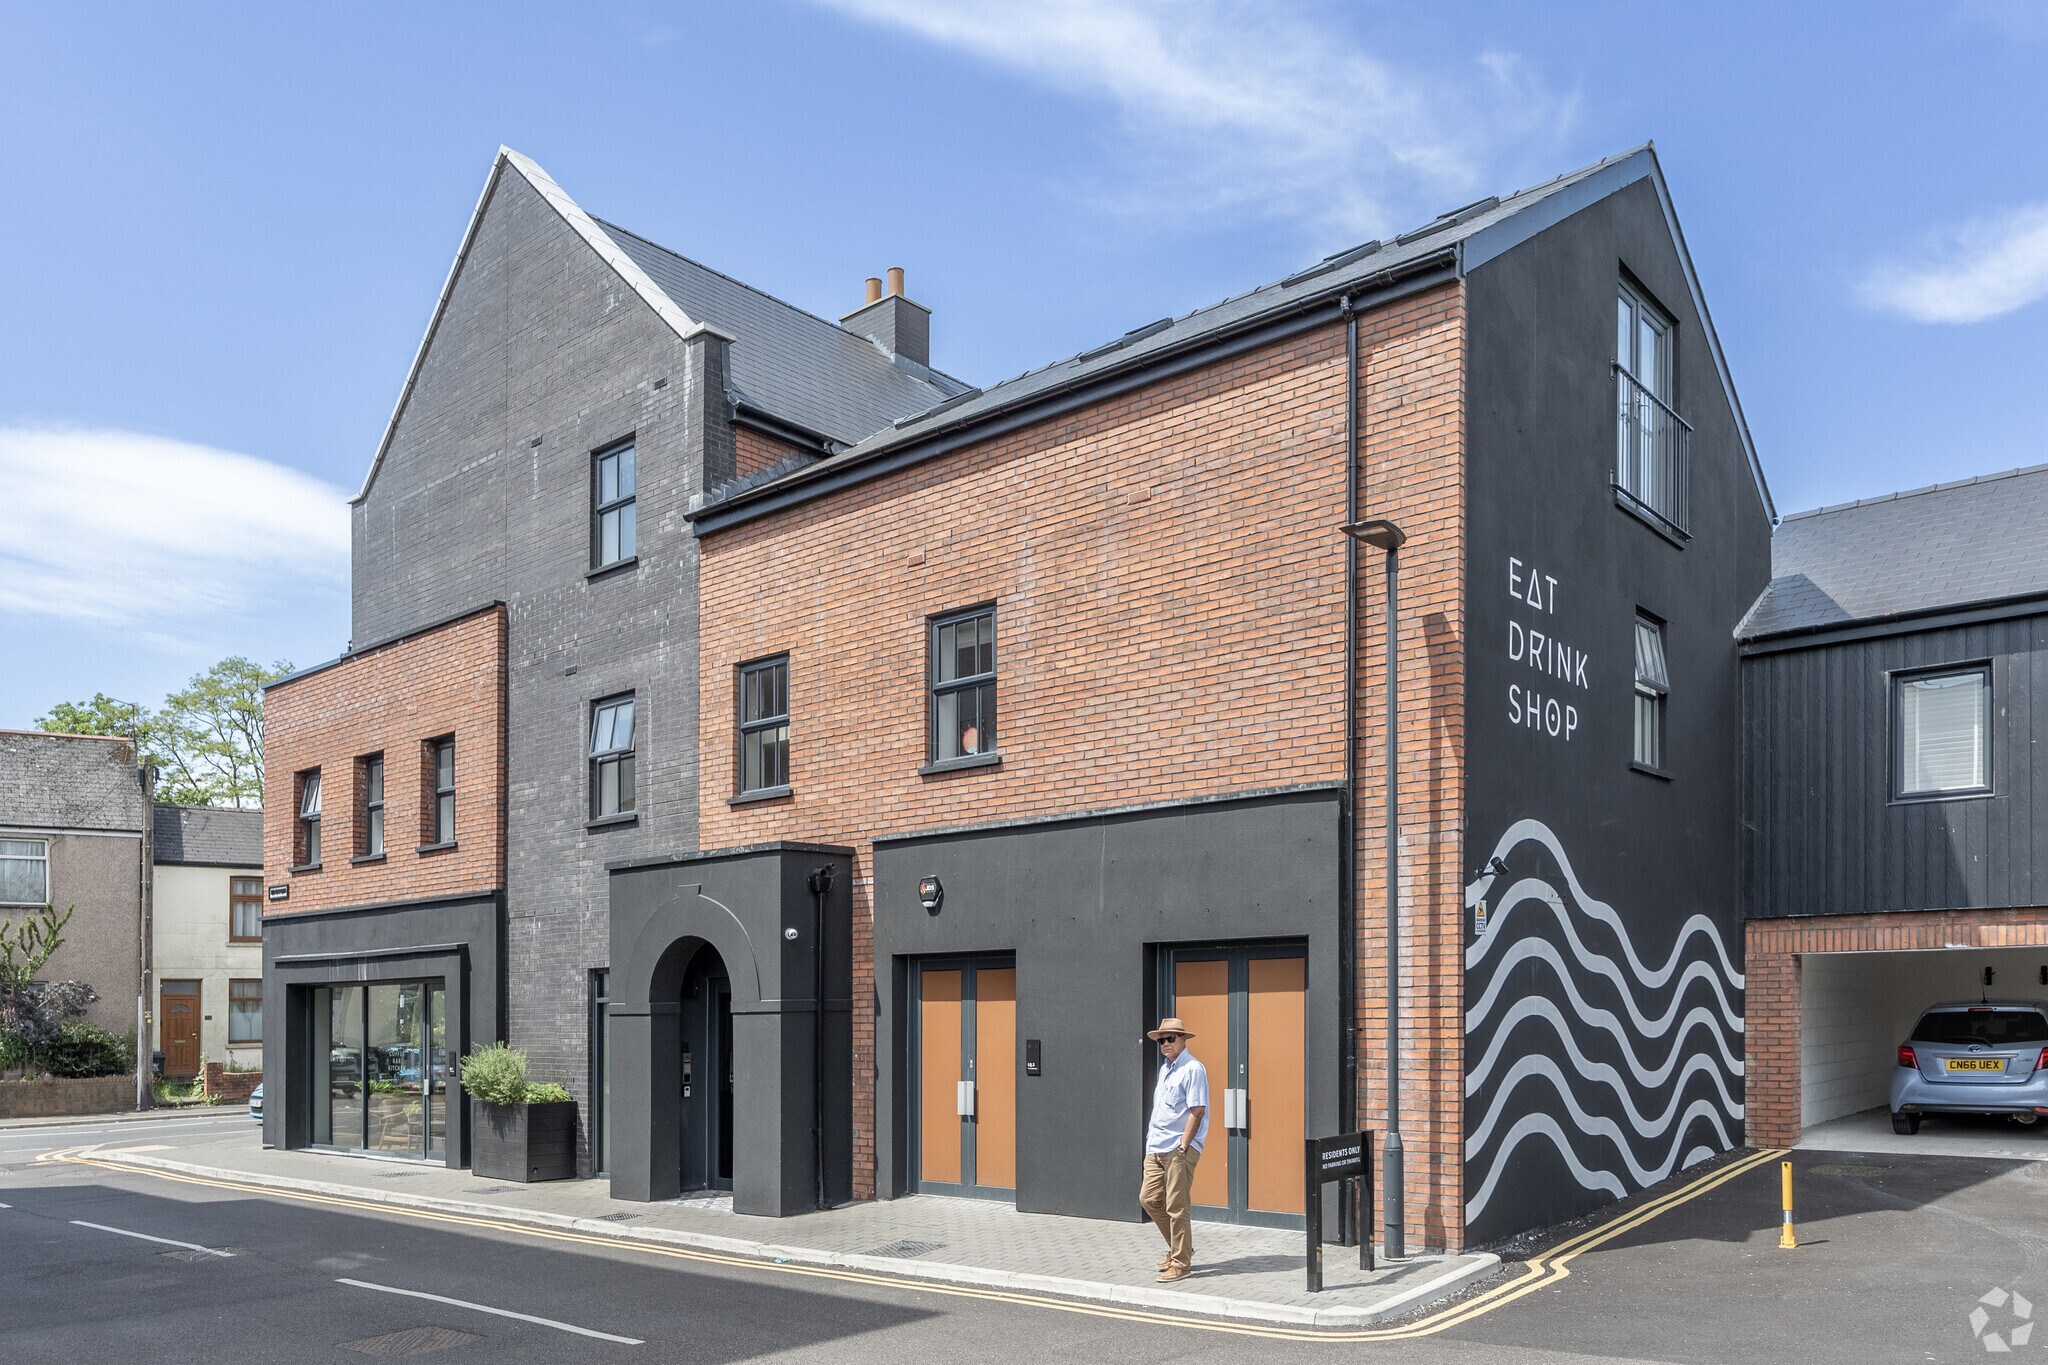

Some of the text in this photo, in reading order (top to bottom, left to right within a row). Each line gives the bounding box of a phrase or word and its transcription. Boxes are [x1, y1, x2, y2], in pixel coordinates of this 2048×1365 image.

[1510, 557, 1558, 614] EAT
[1509, 620, 1588, 689] DRINK
[1508, 684, 1578, 741] SHOP
[1950, 1061, 1999, 1069] CN66 UEX
[1322, 1146, 1361, 1160] RESIDENTS ONLY
